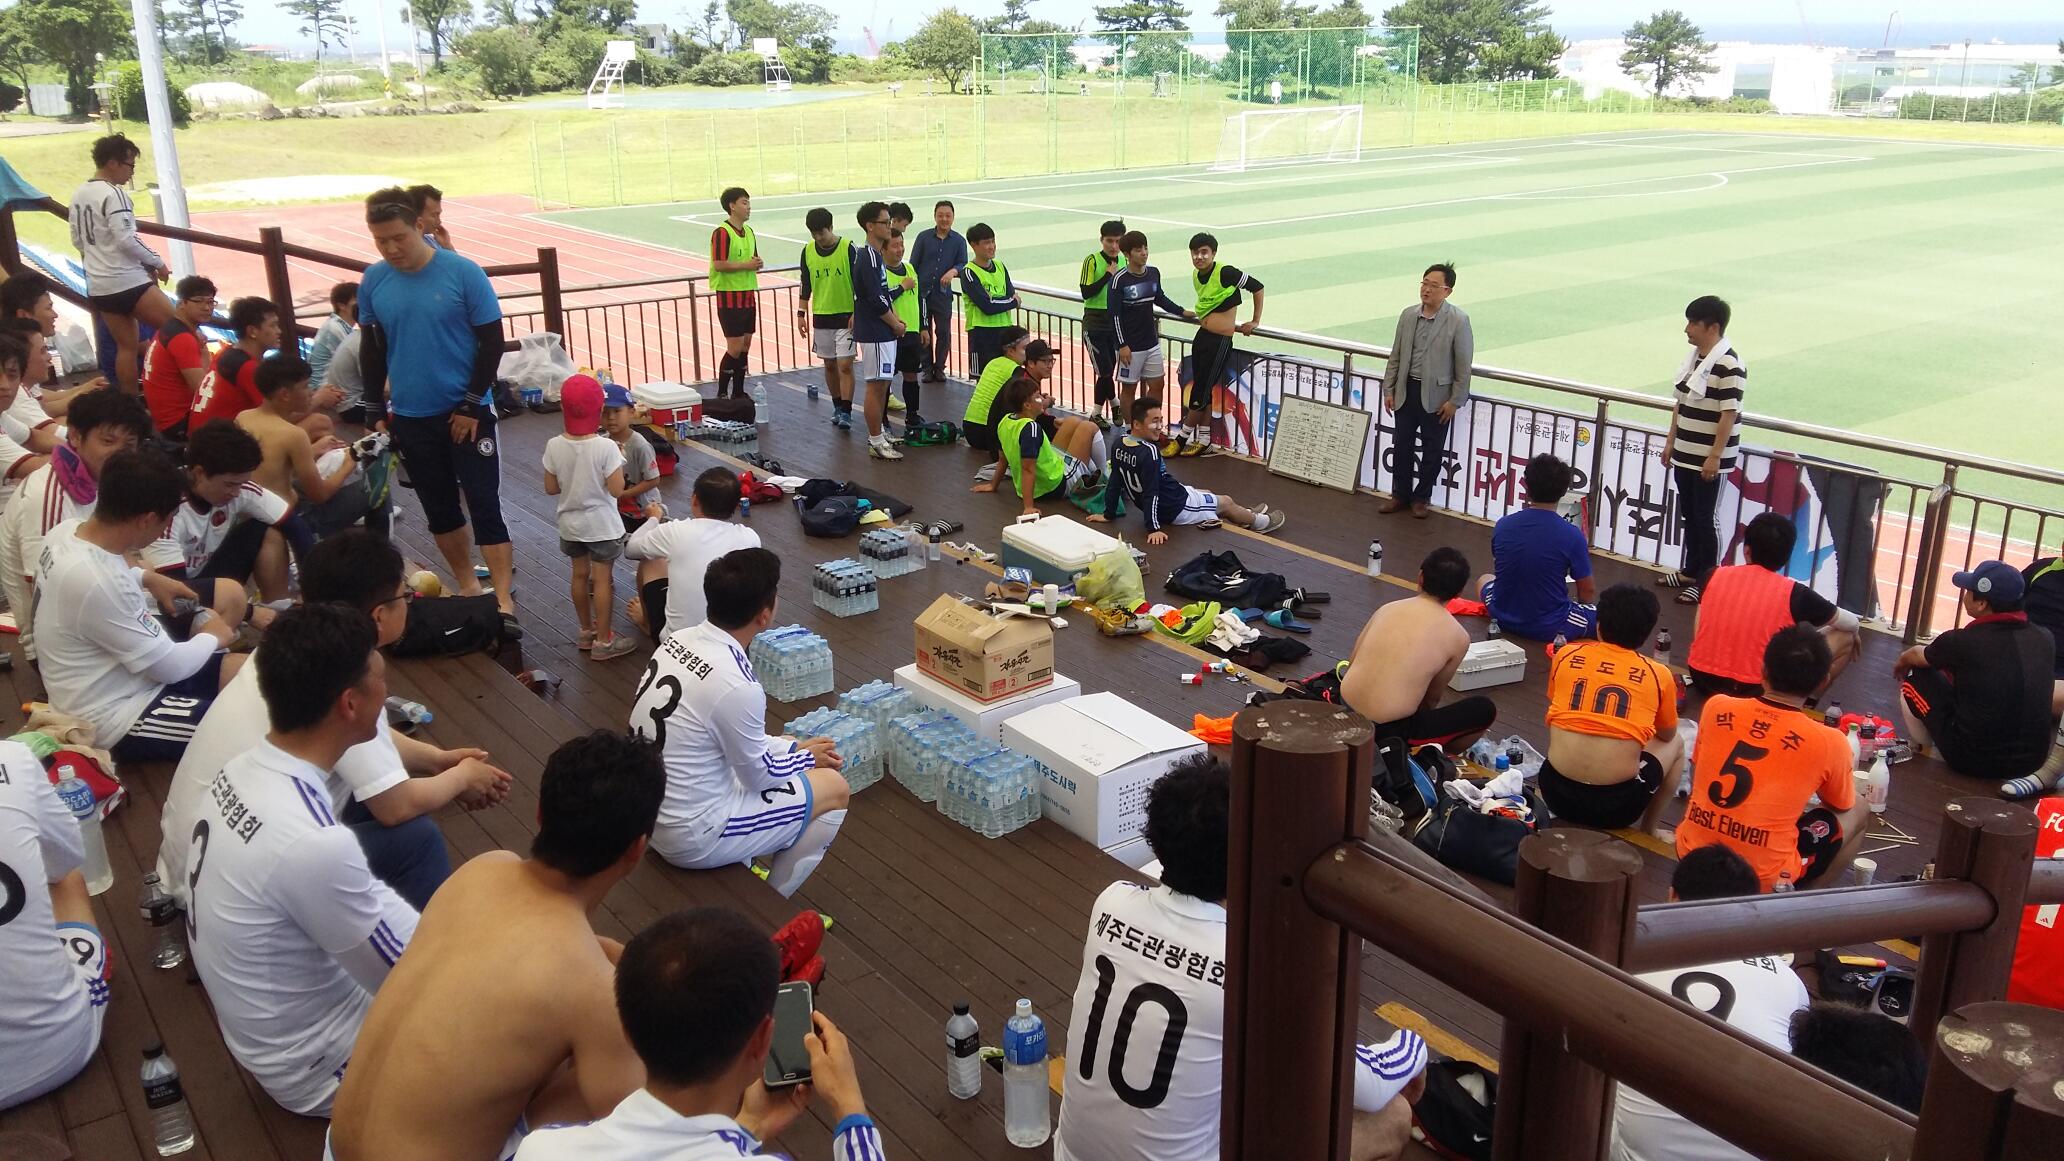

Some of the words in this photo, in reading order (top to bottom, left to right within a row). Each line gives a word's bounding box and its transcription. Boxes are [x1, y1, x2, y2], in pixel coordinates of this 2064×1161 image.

[1707, 739, 1770, 810] 5
[1687, 801, 1717, 831] Best
[1717, 815, 1770, 848] Eleven
[1079, 953, 1188, 1110] 10
